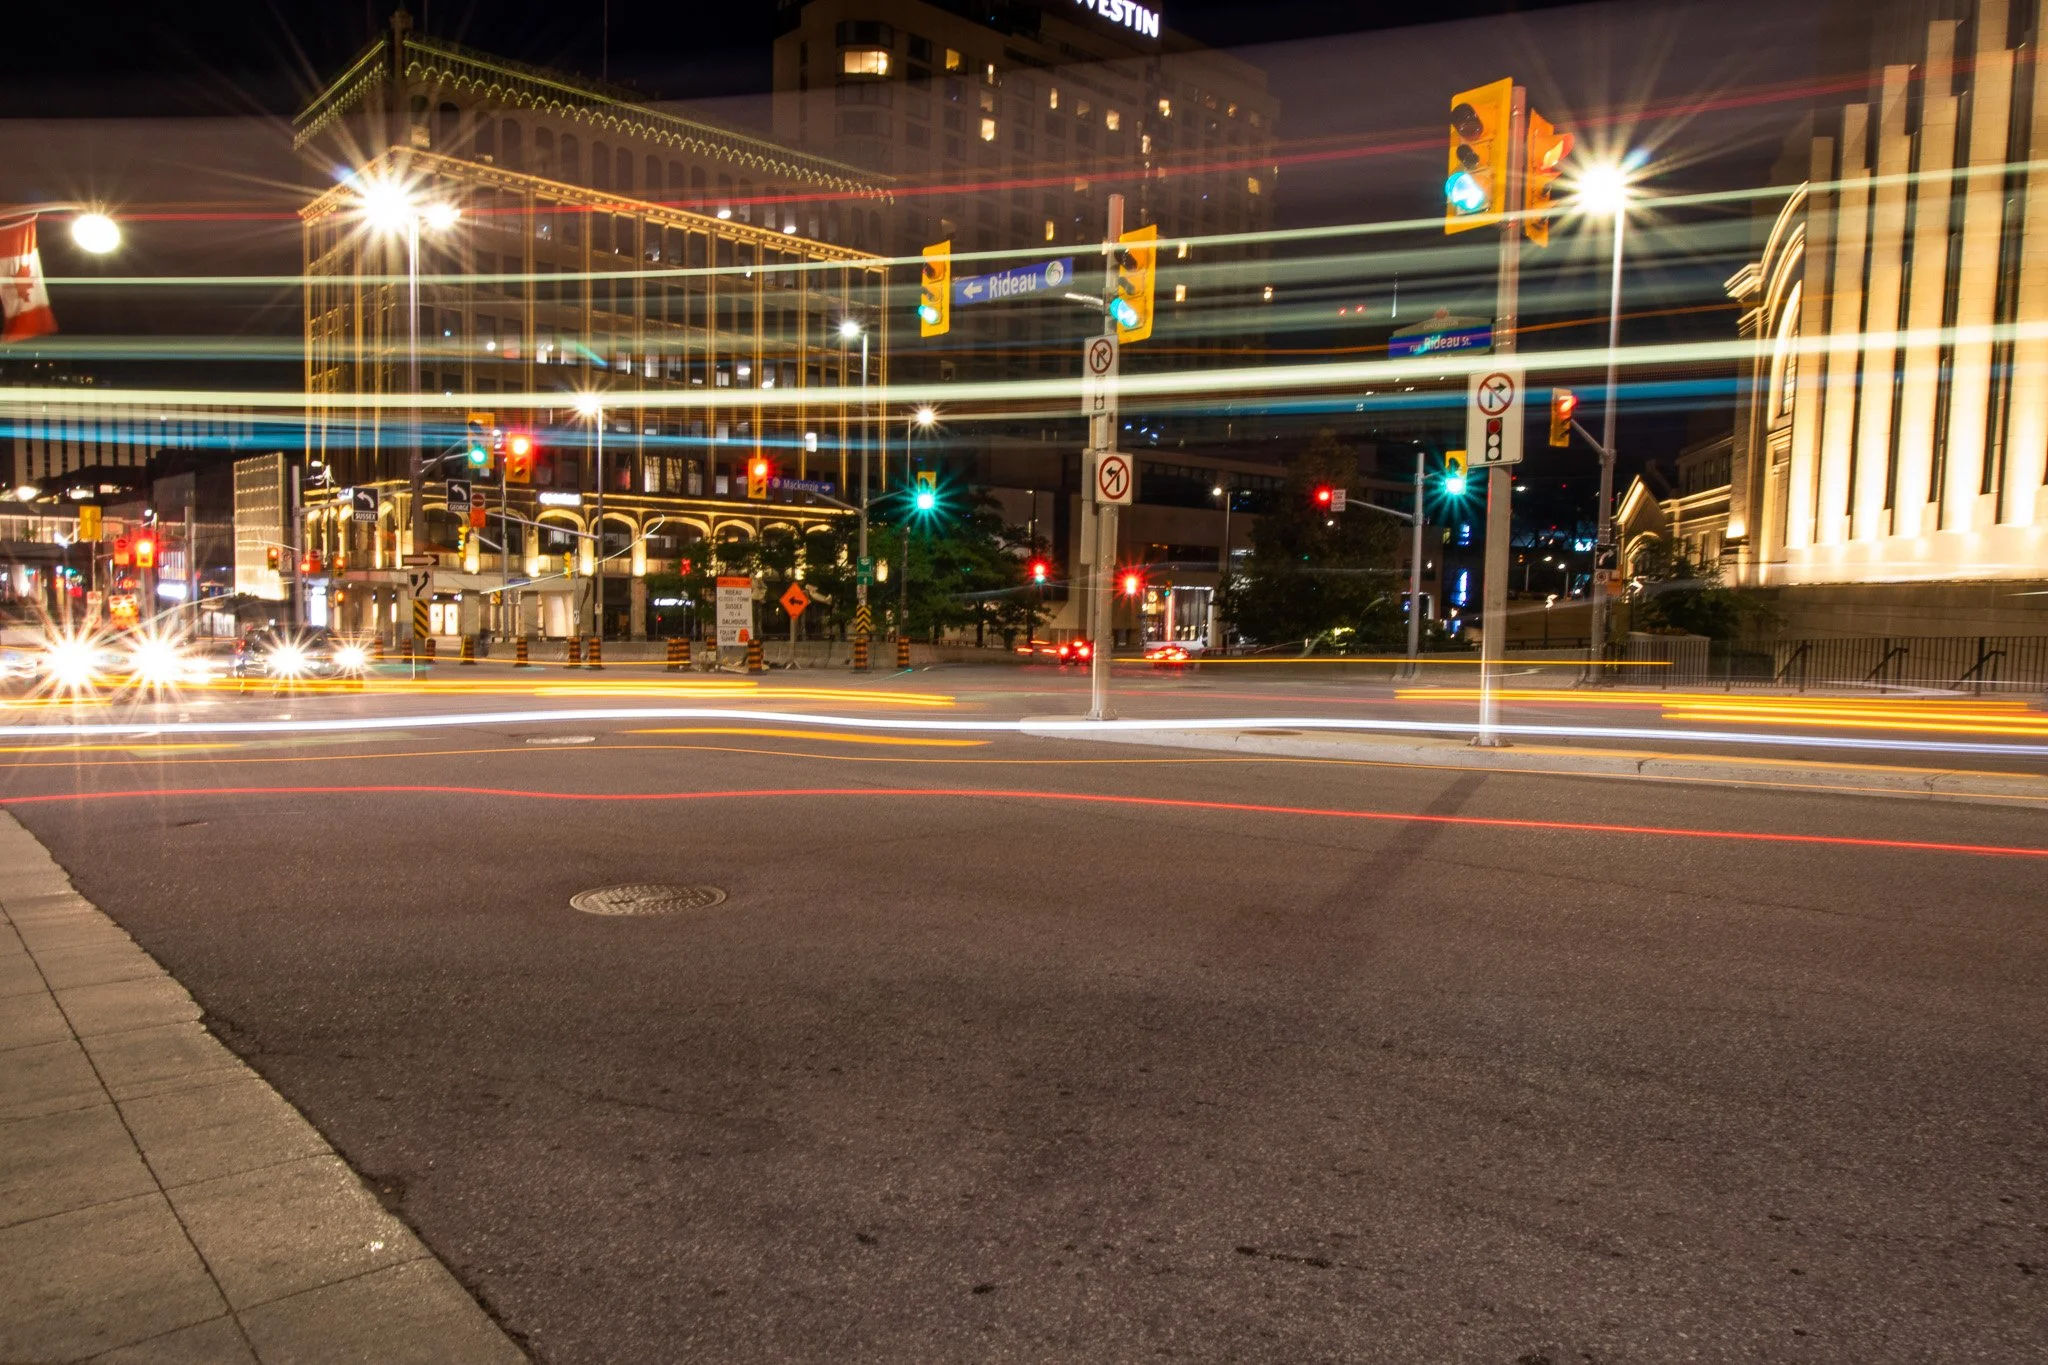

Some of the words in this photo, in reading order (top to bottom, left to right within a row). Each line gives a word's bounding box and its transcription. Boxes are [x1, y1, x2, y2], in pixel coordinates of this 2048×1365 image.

[989, 271, 1036, 298] Rideau
[1423, 335, 1460, 352] Rideau
[783, 480, 819, 492] Mackenzie
[449, 503, 469, 511] GEORGE
[355, 512, 377, 520] SUSSEX
